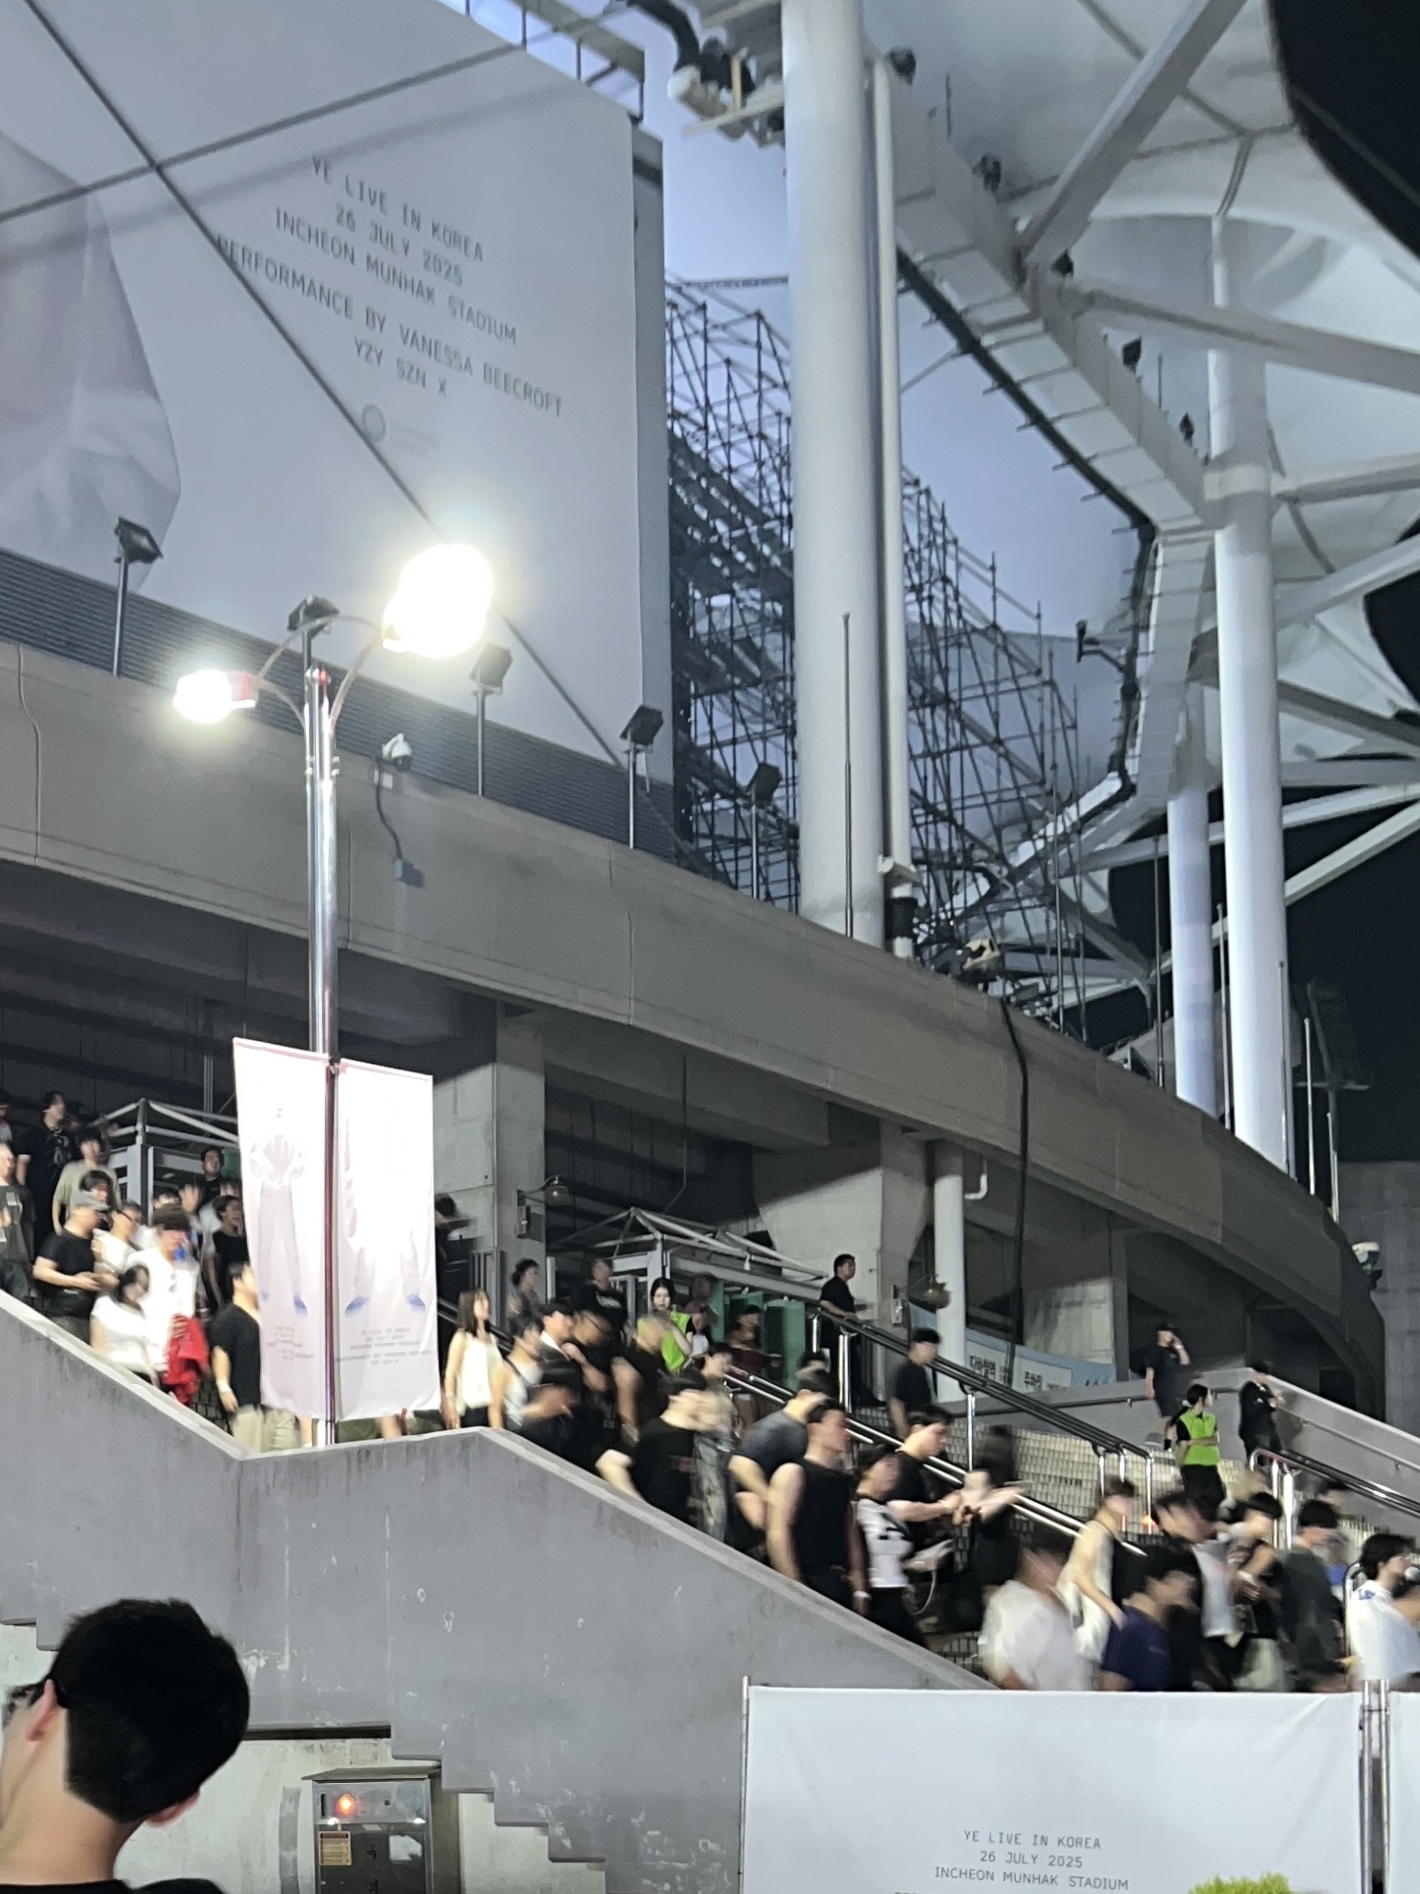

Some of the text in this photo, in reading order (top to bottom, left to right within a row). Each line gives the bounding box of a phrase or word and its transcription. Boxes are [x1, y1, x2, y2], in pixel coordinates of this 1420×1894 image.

[311, 155, 484, 262] YE LIVE IN KOREA
[335, 203, 463, 287] 26 JULY 2025
[275, 207, 517, 345] INCHEON MUNHAK STADIUM
[216, 232, 563, 418] PERFORMANCE BY VANESSA BEECROFT
[354, 336, 448, 398] YZY SZN X
[964, 1830, 1101, 1849] YE LIVE IN KOREA
[980, 1850, 1083, 1868] 26 JULY 2025
[935, 1866, 1129, 1891] INCHEON MUNHAK STADIUM
